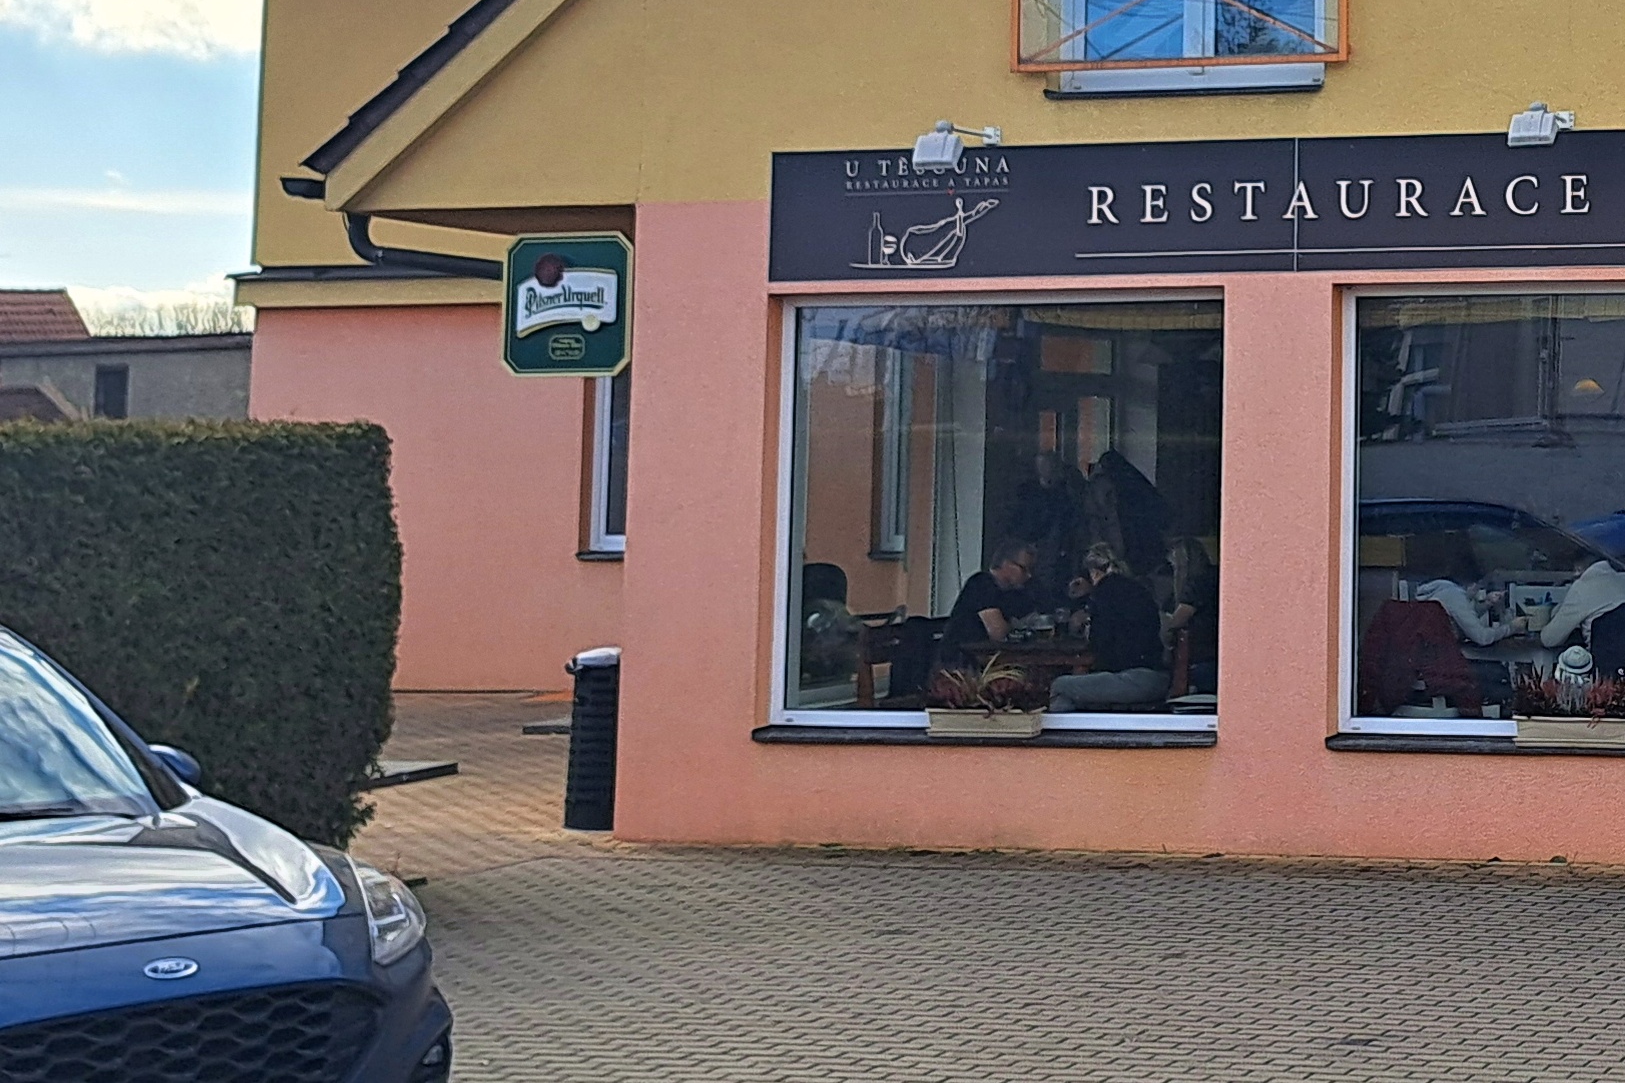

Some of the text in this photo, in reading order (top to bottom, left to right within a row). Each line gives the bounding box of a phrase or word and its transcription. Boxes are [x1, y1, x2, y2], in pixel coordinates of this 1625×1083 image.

[846, 160, 859, 177] U
[846, 176, 1009, 190] RESTAURACE A TAPAS
[1087, 174, 1591, 224] RESTAURACE
[525, 284, 604, 319] Pilsner Urquell
